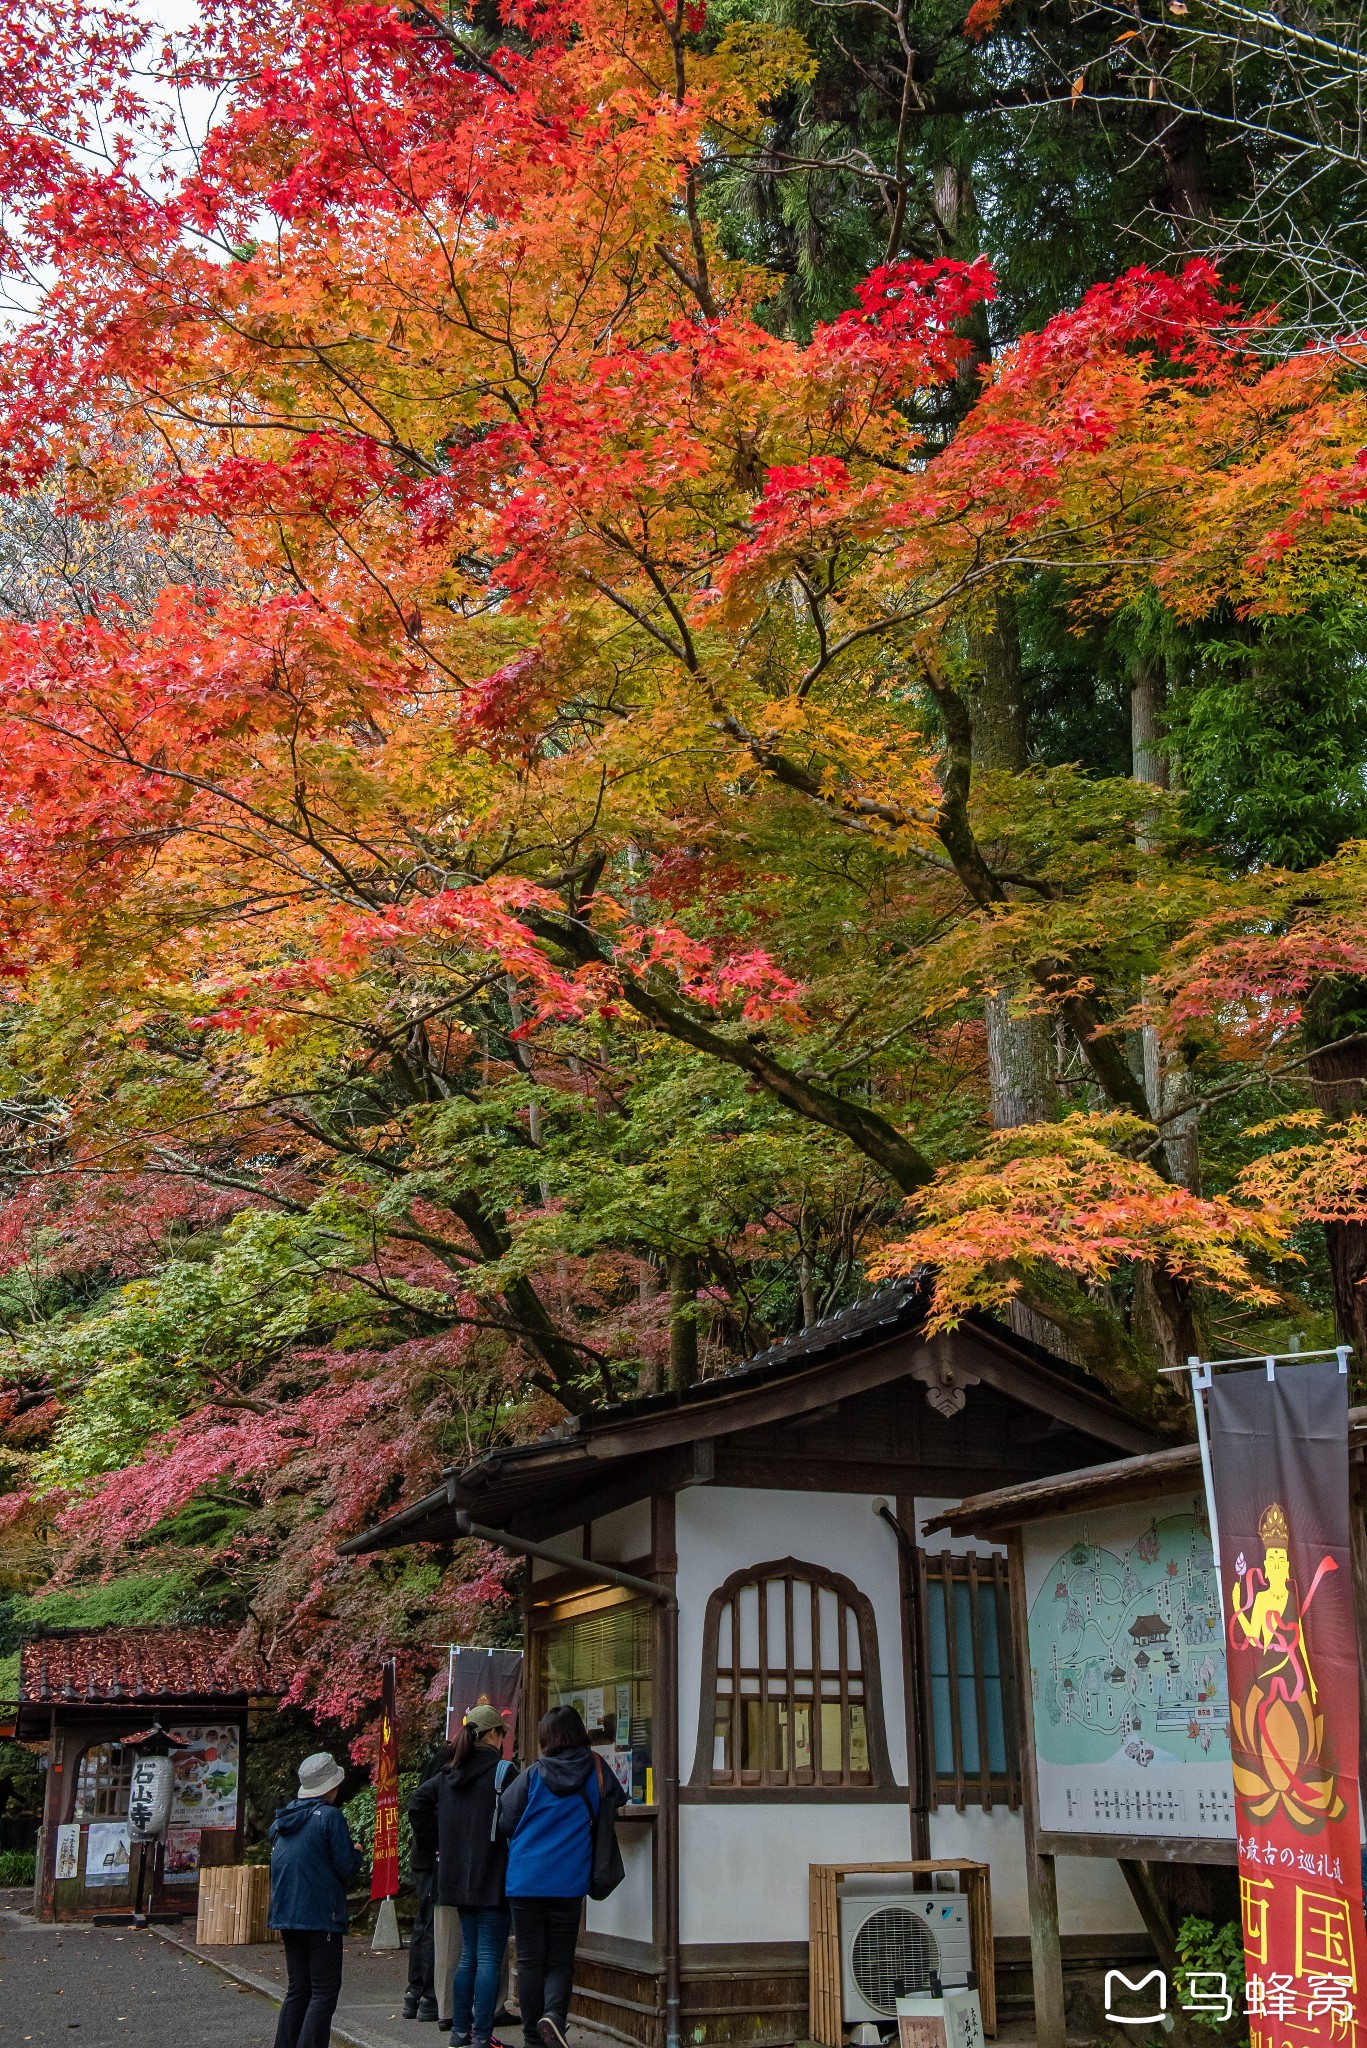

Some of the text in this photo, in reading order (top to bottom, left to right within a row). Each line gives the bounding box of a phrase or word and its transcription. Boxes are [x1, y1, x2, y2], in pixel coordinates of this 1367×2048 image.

[131, 1763, 157, 1830] 石山寺
[1239, 1875, 1358, 1994] 西国
[964, 2019, 974, 2048] 石山
